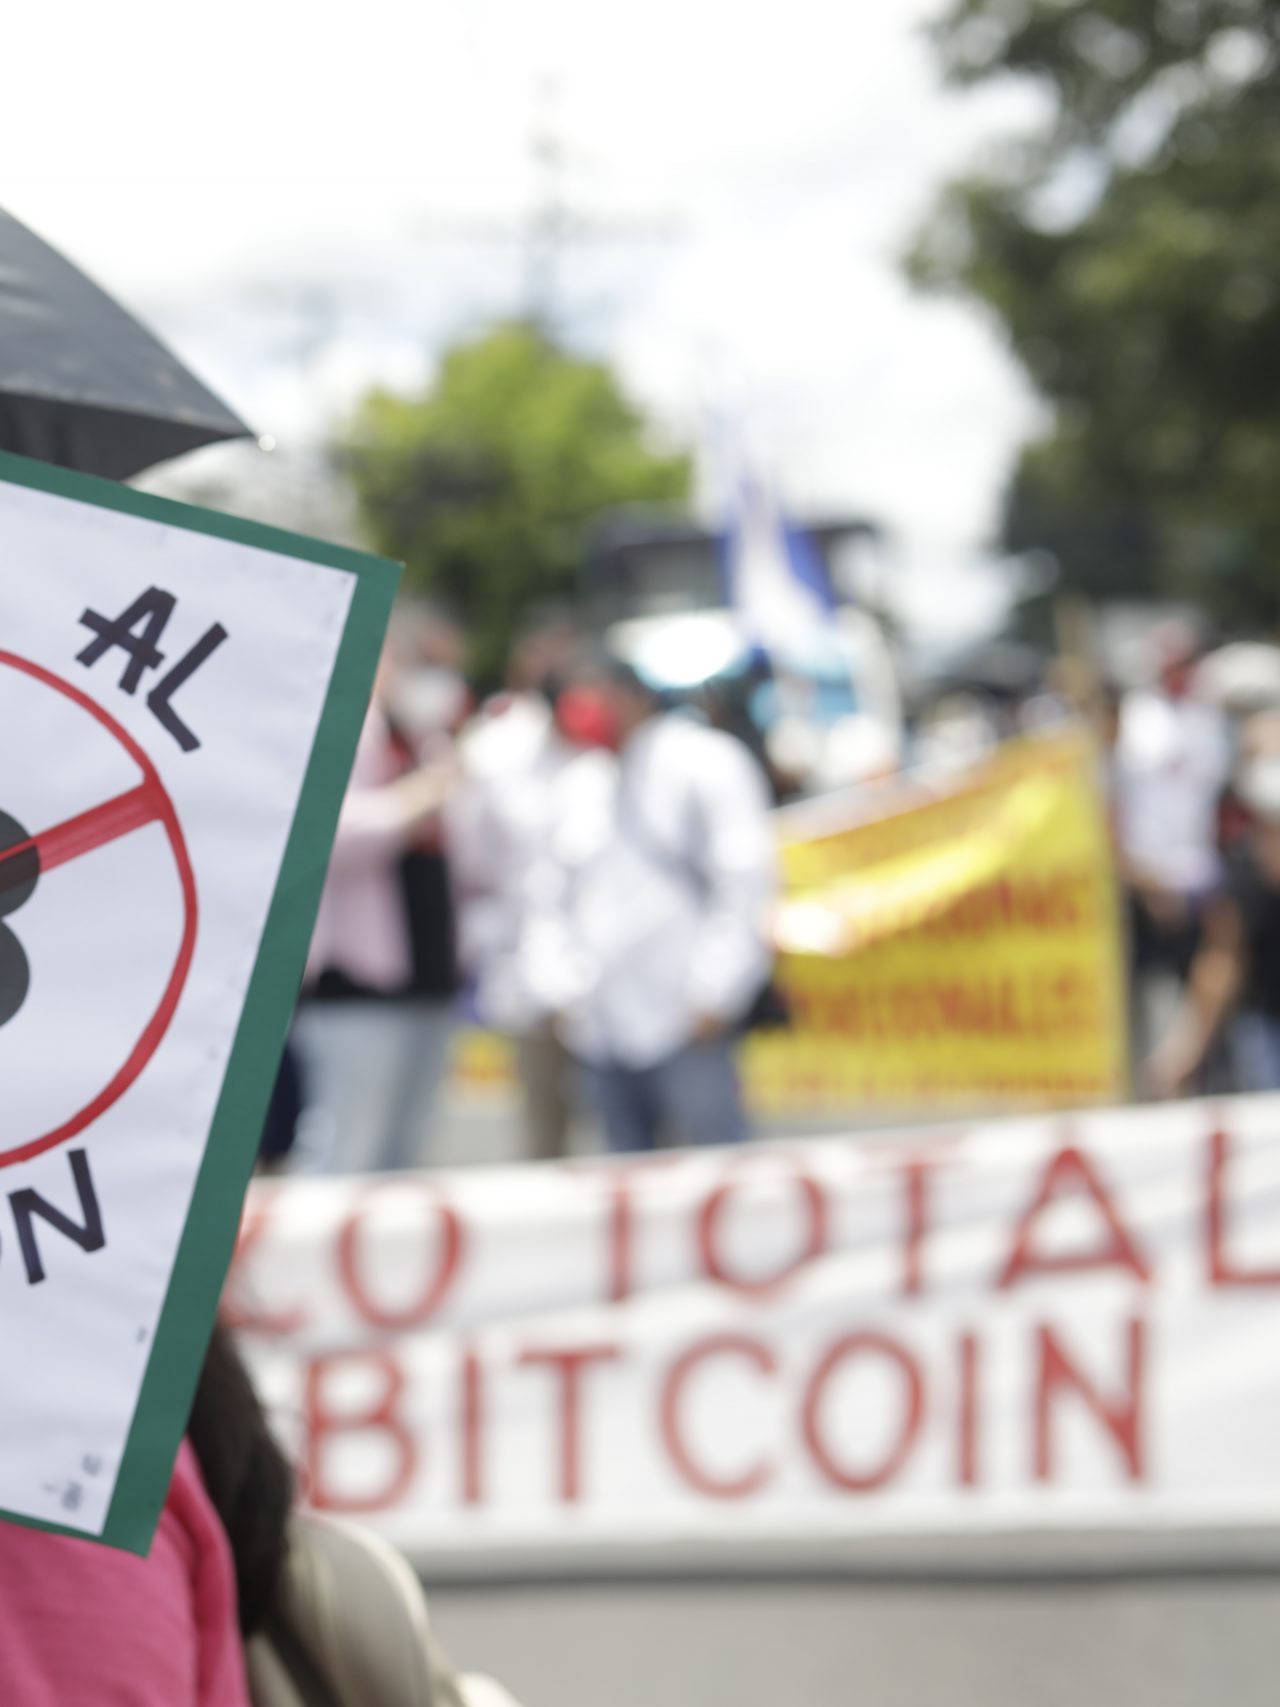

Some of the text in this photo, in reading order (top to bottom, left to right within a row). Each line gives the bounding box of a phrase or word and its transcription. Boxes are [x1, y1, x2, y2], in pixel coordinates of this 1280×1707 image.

[75, 585, 229, 753] AL
[558, 1122, 1280, 1302] TOTAL
[294, 1316, 1149, 1516] BITCOIN
